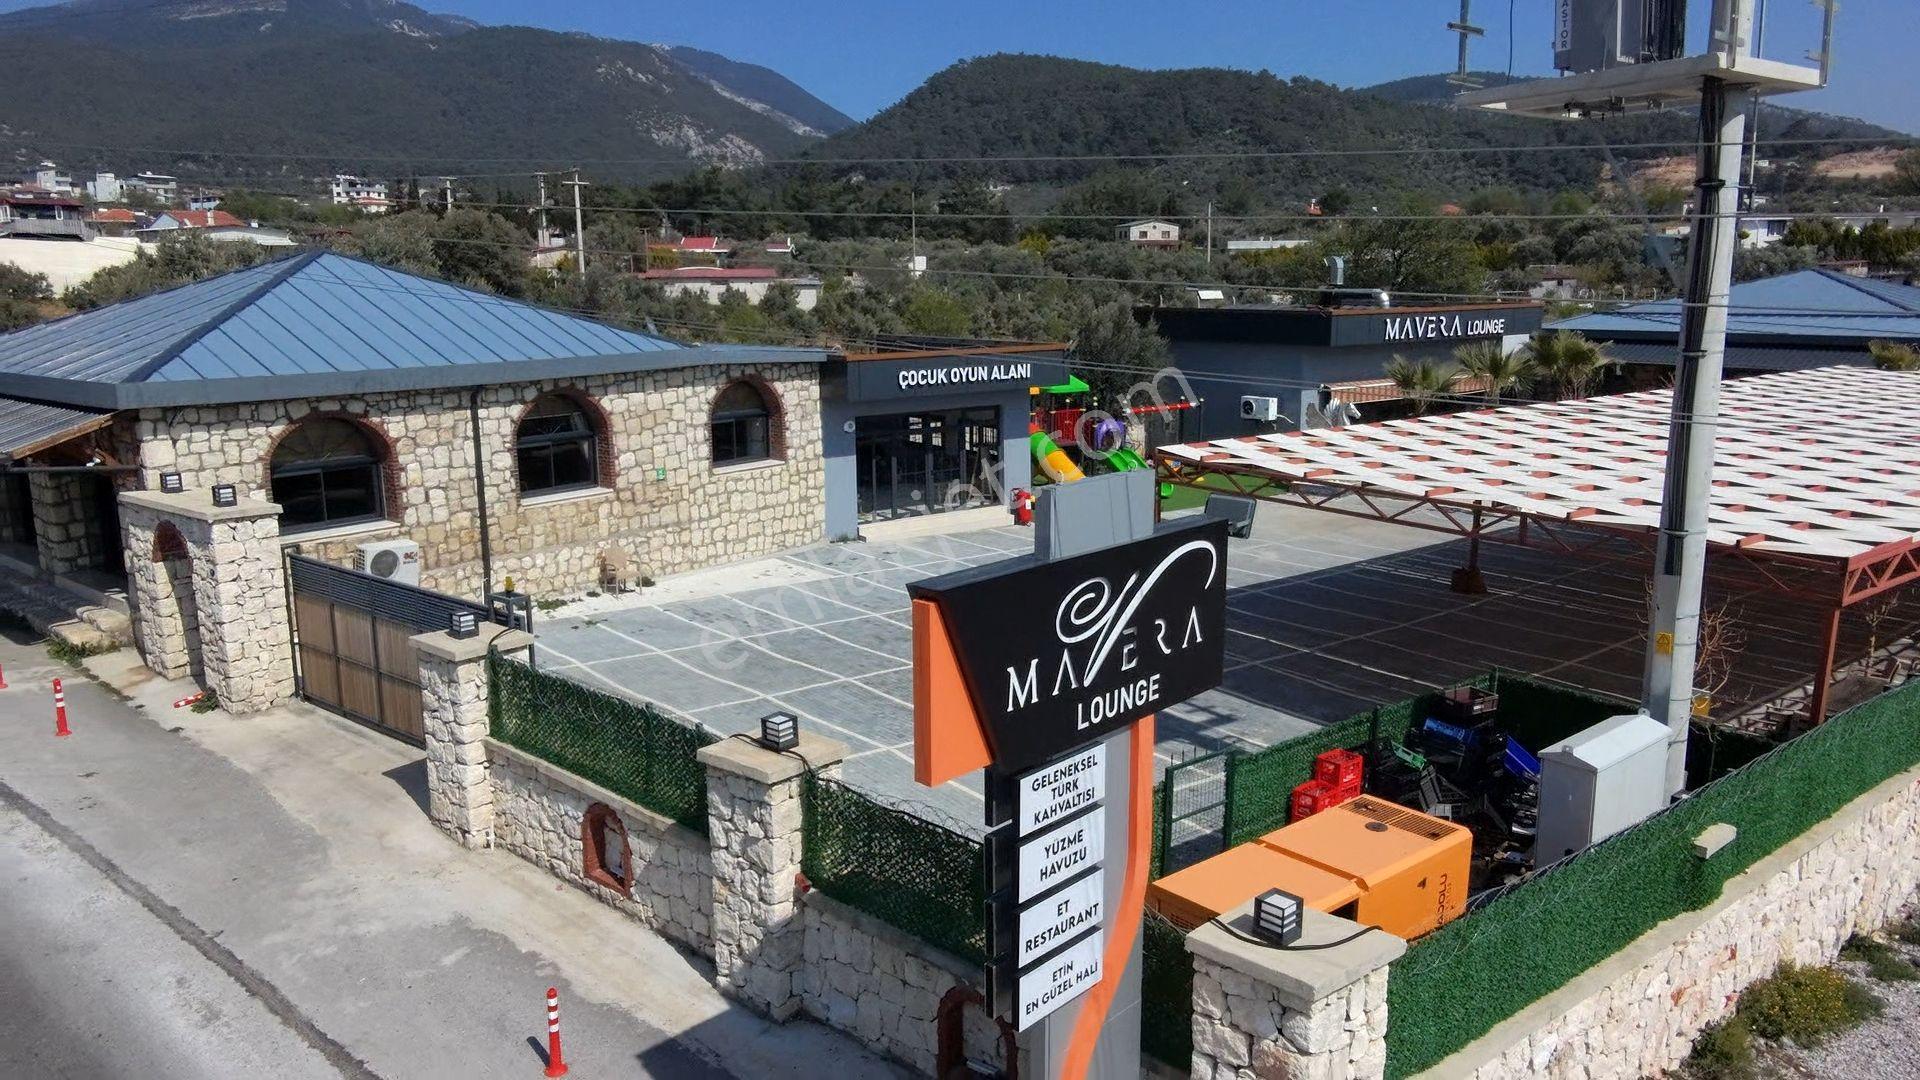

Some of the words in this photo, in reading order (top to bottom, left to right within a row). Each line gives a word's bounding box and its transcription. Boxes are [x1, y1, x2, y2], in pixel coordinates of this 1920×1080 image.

[1385, 315, 1462, 340] MAVERA
[1467, 319, 1506, 335] LOUNGE
[899, 368, 948, 390] ÇOCUK
[950, 365, 988, 383] OYUN
[990, 363, 1031, 380] ALANI
[1007, 540, 1217, 712] MAVERA
[1077, 673, 1161, 731] LOUNGE
[1031, 753, 1099, 792] GELENEKSEL
[1033, 786, 1096, 826] KAHVALTISI
[1044, 829, 1084, 859] YÜZME
[1039, 846, 1087, 881] HAVUZU
[1057, 899, 1071, 917] ET
[1025, 902, 1100, 953] RESTAURANT
[1052, 960, 1074, 983] ETİN
[1025, 998, 1039, 1016] EN
